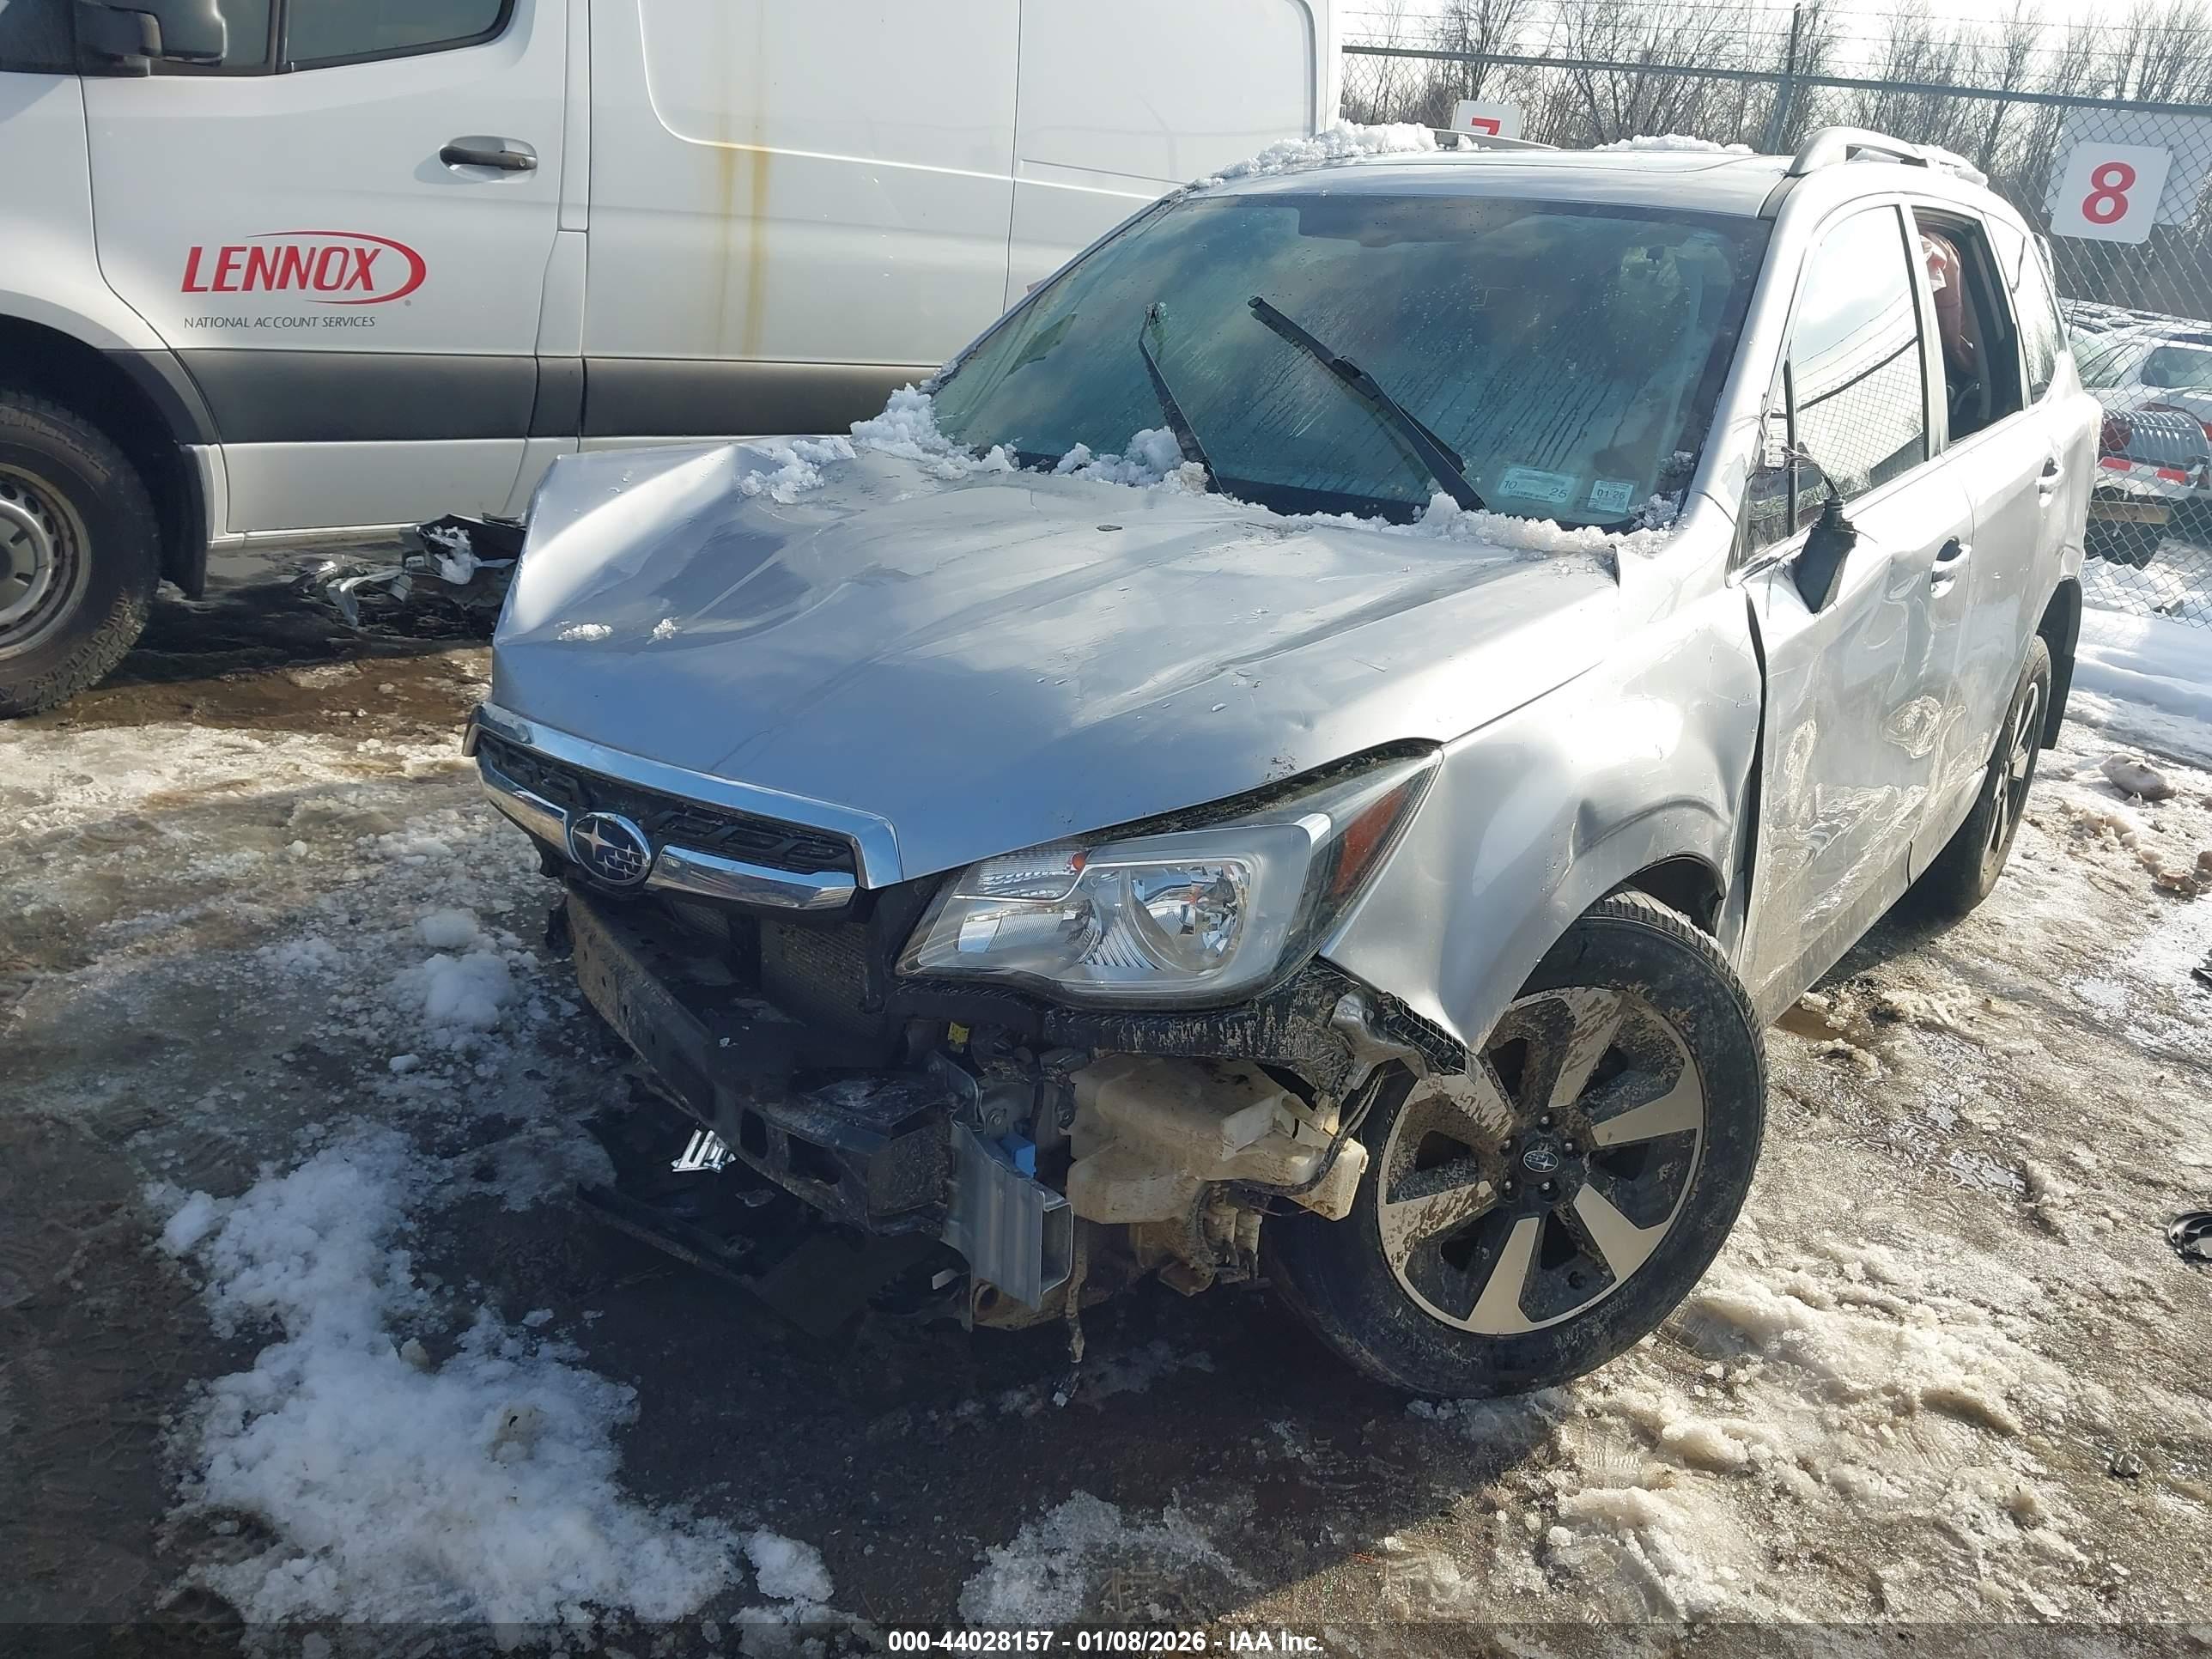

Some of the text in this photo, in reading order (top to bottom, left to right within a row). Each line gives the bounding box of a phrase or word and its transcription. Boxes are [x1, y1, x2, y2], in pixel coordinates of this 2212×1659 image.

[2081, 161, 2136, 225] 8
[180, 246, 381, 292] LENNOX
[184, 316, 376, 329] NATIONAL ACCOUNT SERVICES
[1504, 480, 1518, 489] 10
[1549, 487, 1568, 498] 25
